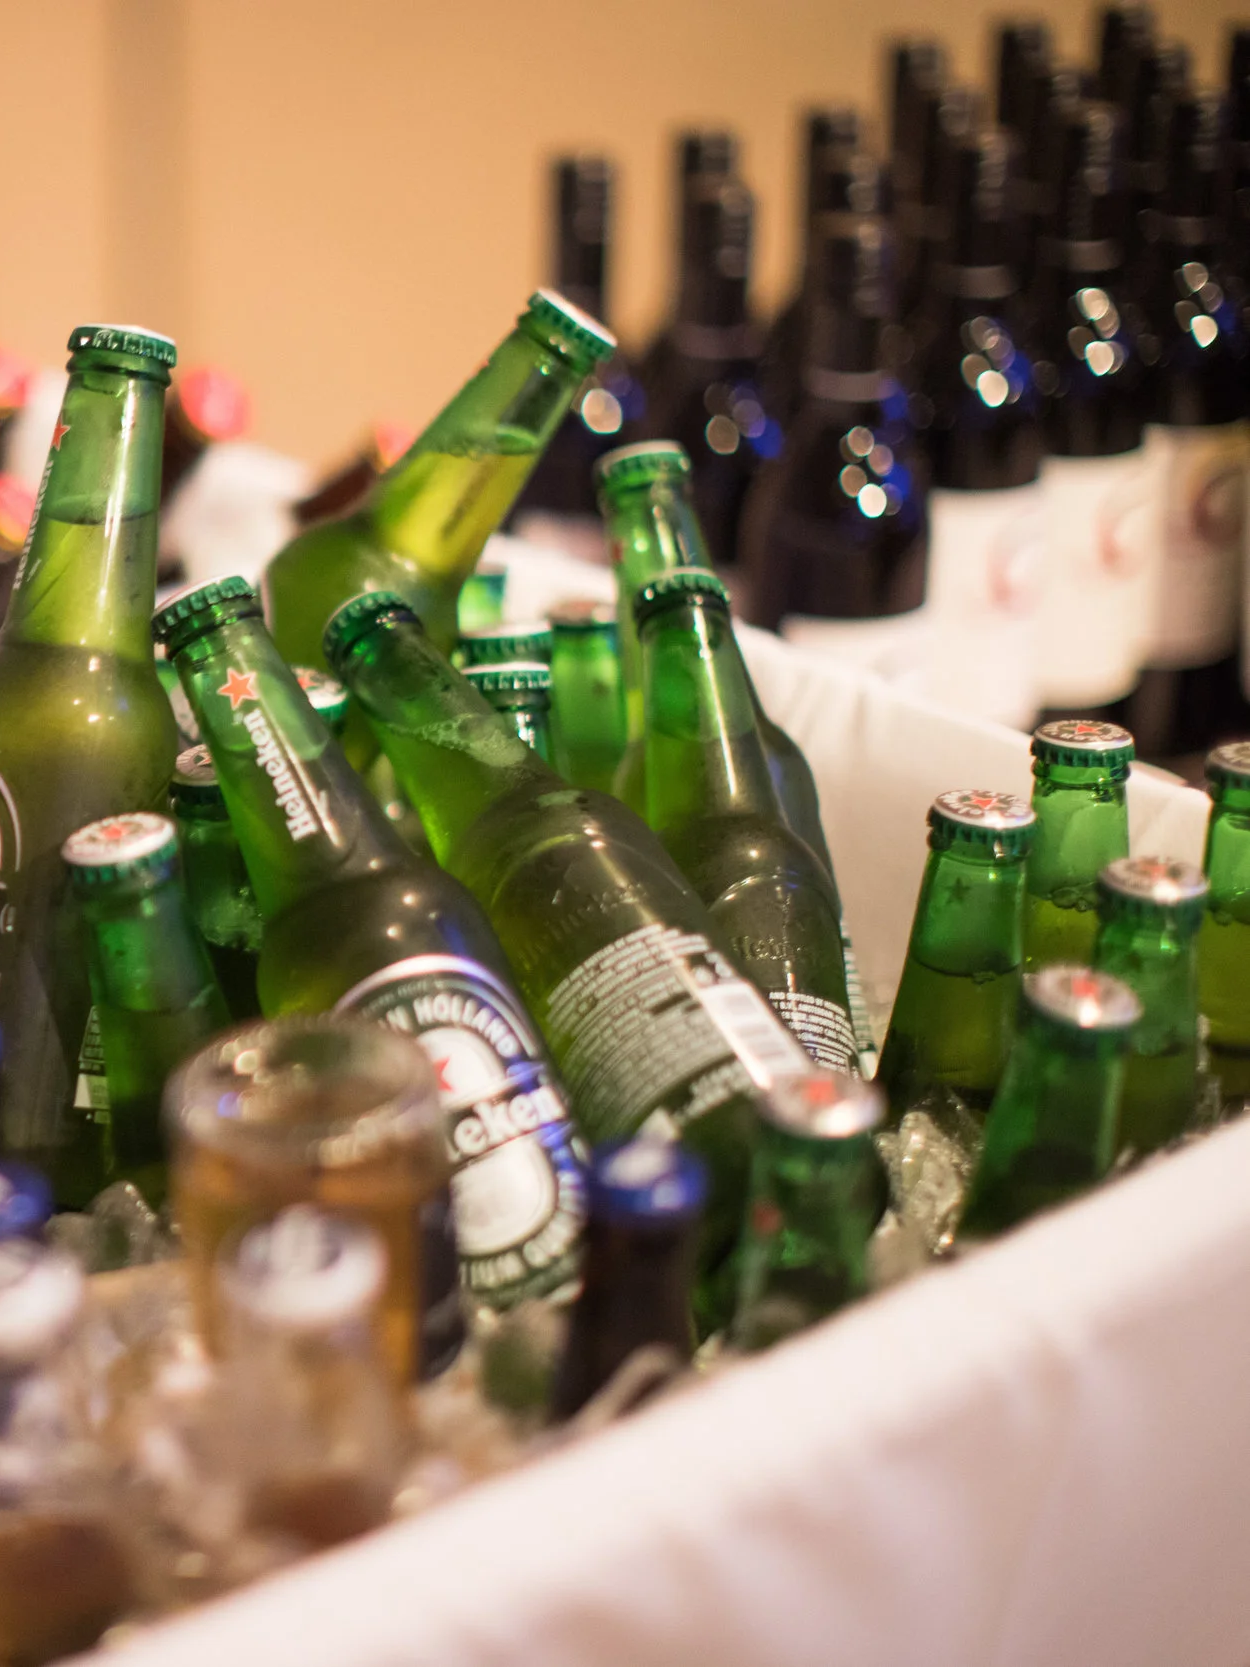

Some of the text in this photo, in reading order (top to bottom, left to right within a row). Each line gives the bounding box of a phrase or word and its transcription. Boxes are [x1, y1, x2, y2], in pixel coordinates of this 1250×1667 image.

[243, 708, 319, 842] Heineken
[413, 993, 519, 1059] HOLLAND
[452, 1085, 567, 1157] eken
